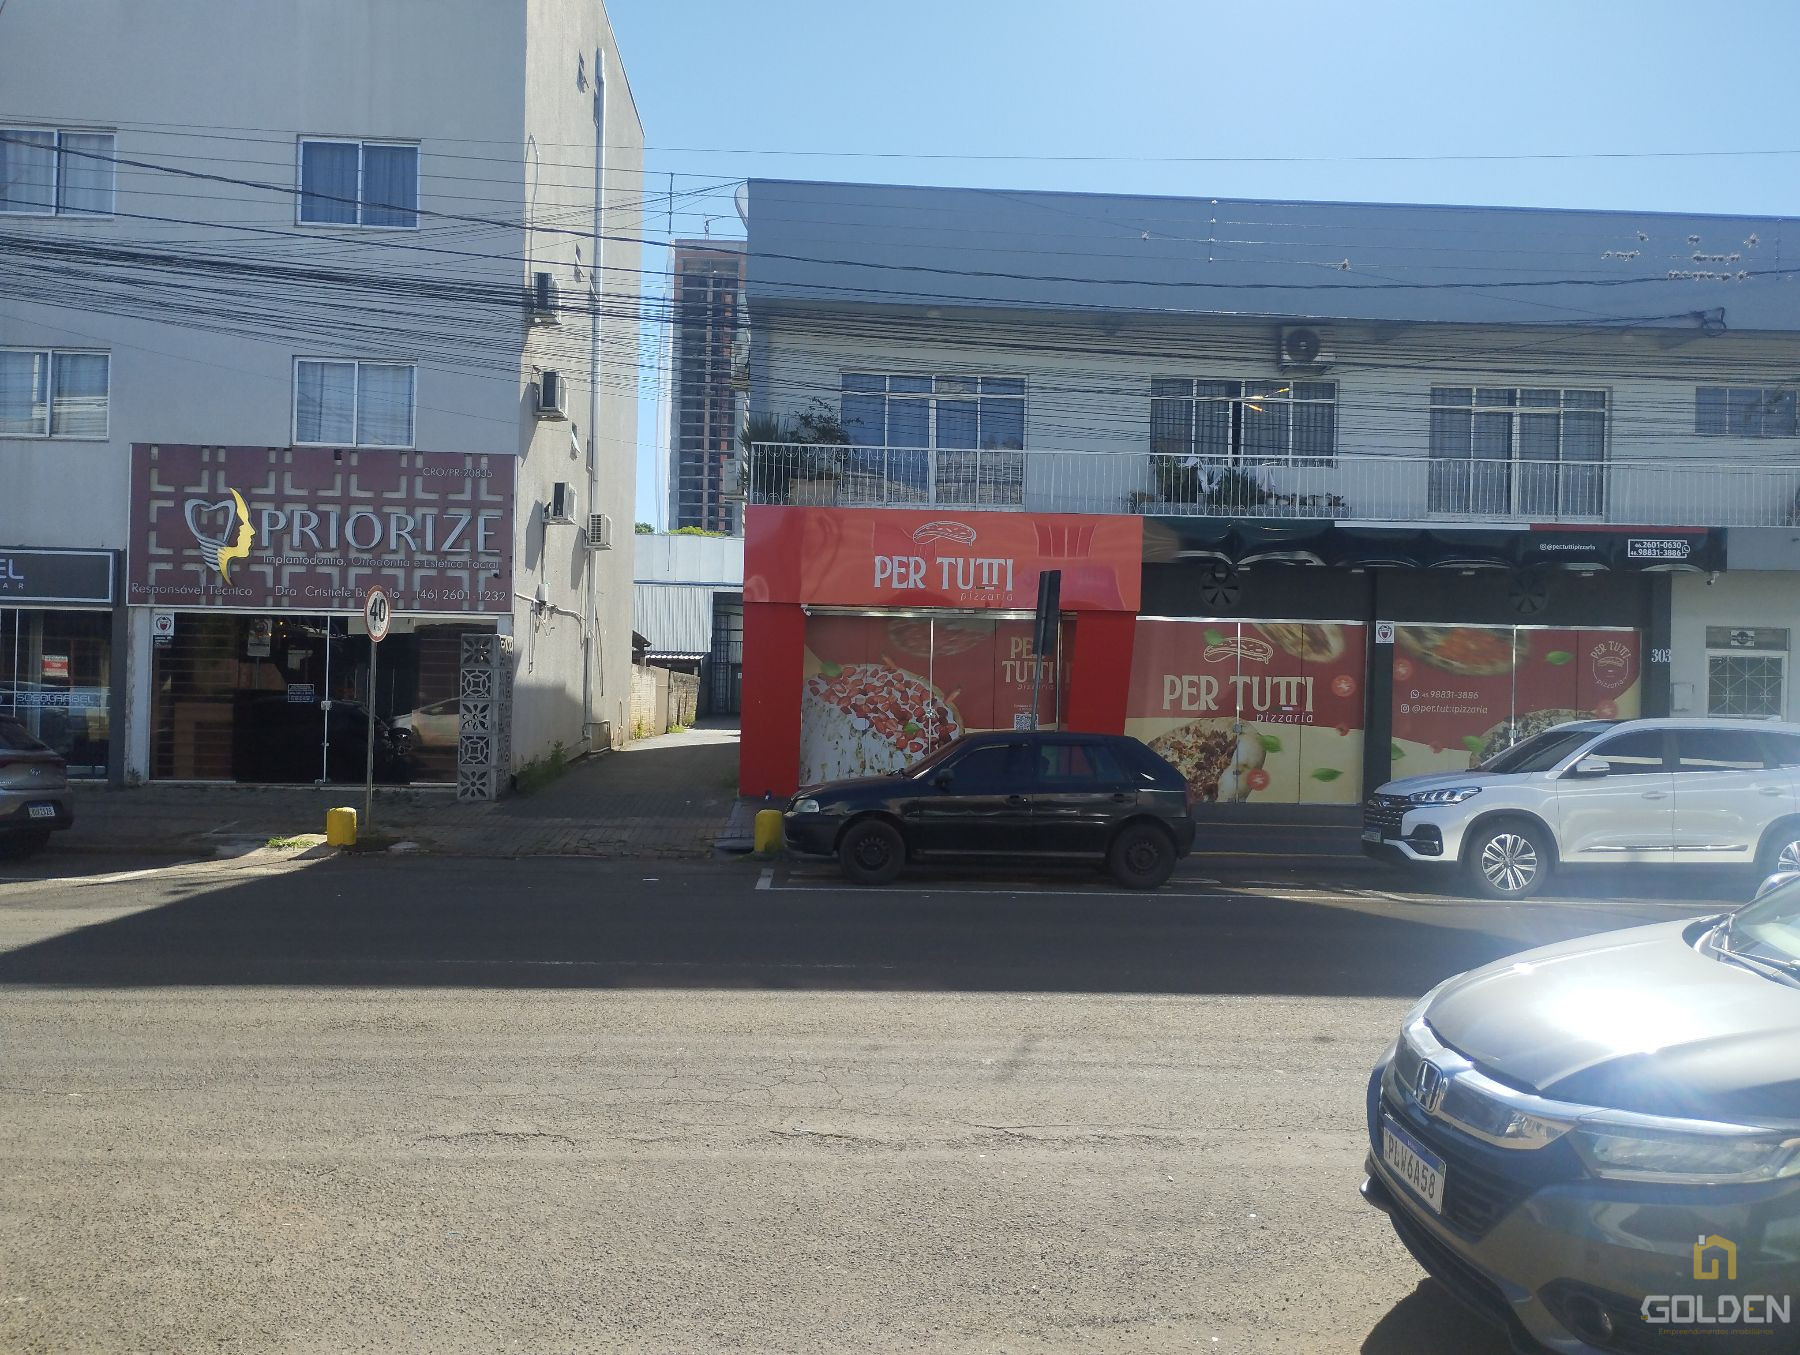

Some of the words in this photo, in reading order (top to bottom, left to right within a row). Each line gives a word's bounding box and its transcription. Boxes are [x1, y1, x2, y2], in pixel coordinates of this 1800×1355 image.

[261, 509, 502, 553] PRIORIZE
[351, 556, 410, 567] Ortodontia
[467, 558, 499, 569] Facial
[874, 555, 927, 589] PER
[936, 556, 1014, 592] TUTTI
[131, 582, 204, 596] Responsável
[416, 588, 438, 600] (46)
[960, 592, 1013, 601] pizzaria
[370, 597, 386, 622] 40
[1590, 643, 1607, 659] PER
[1608, 640, 1632, 659] TUTTI
[1651, 648, 1671, 663] 303
[1001, 660, 1054, 683] TUTTI
[1162, 674, 1220, 711] PER
[1228, 675, 1314, 712] TUTTI
[1256, 711, 1314, 724] pizzaria
[1388, 1134, 1436, 1199] PLW6A58
